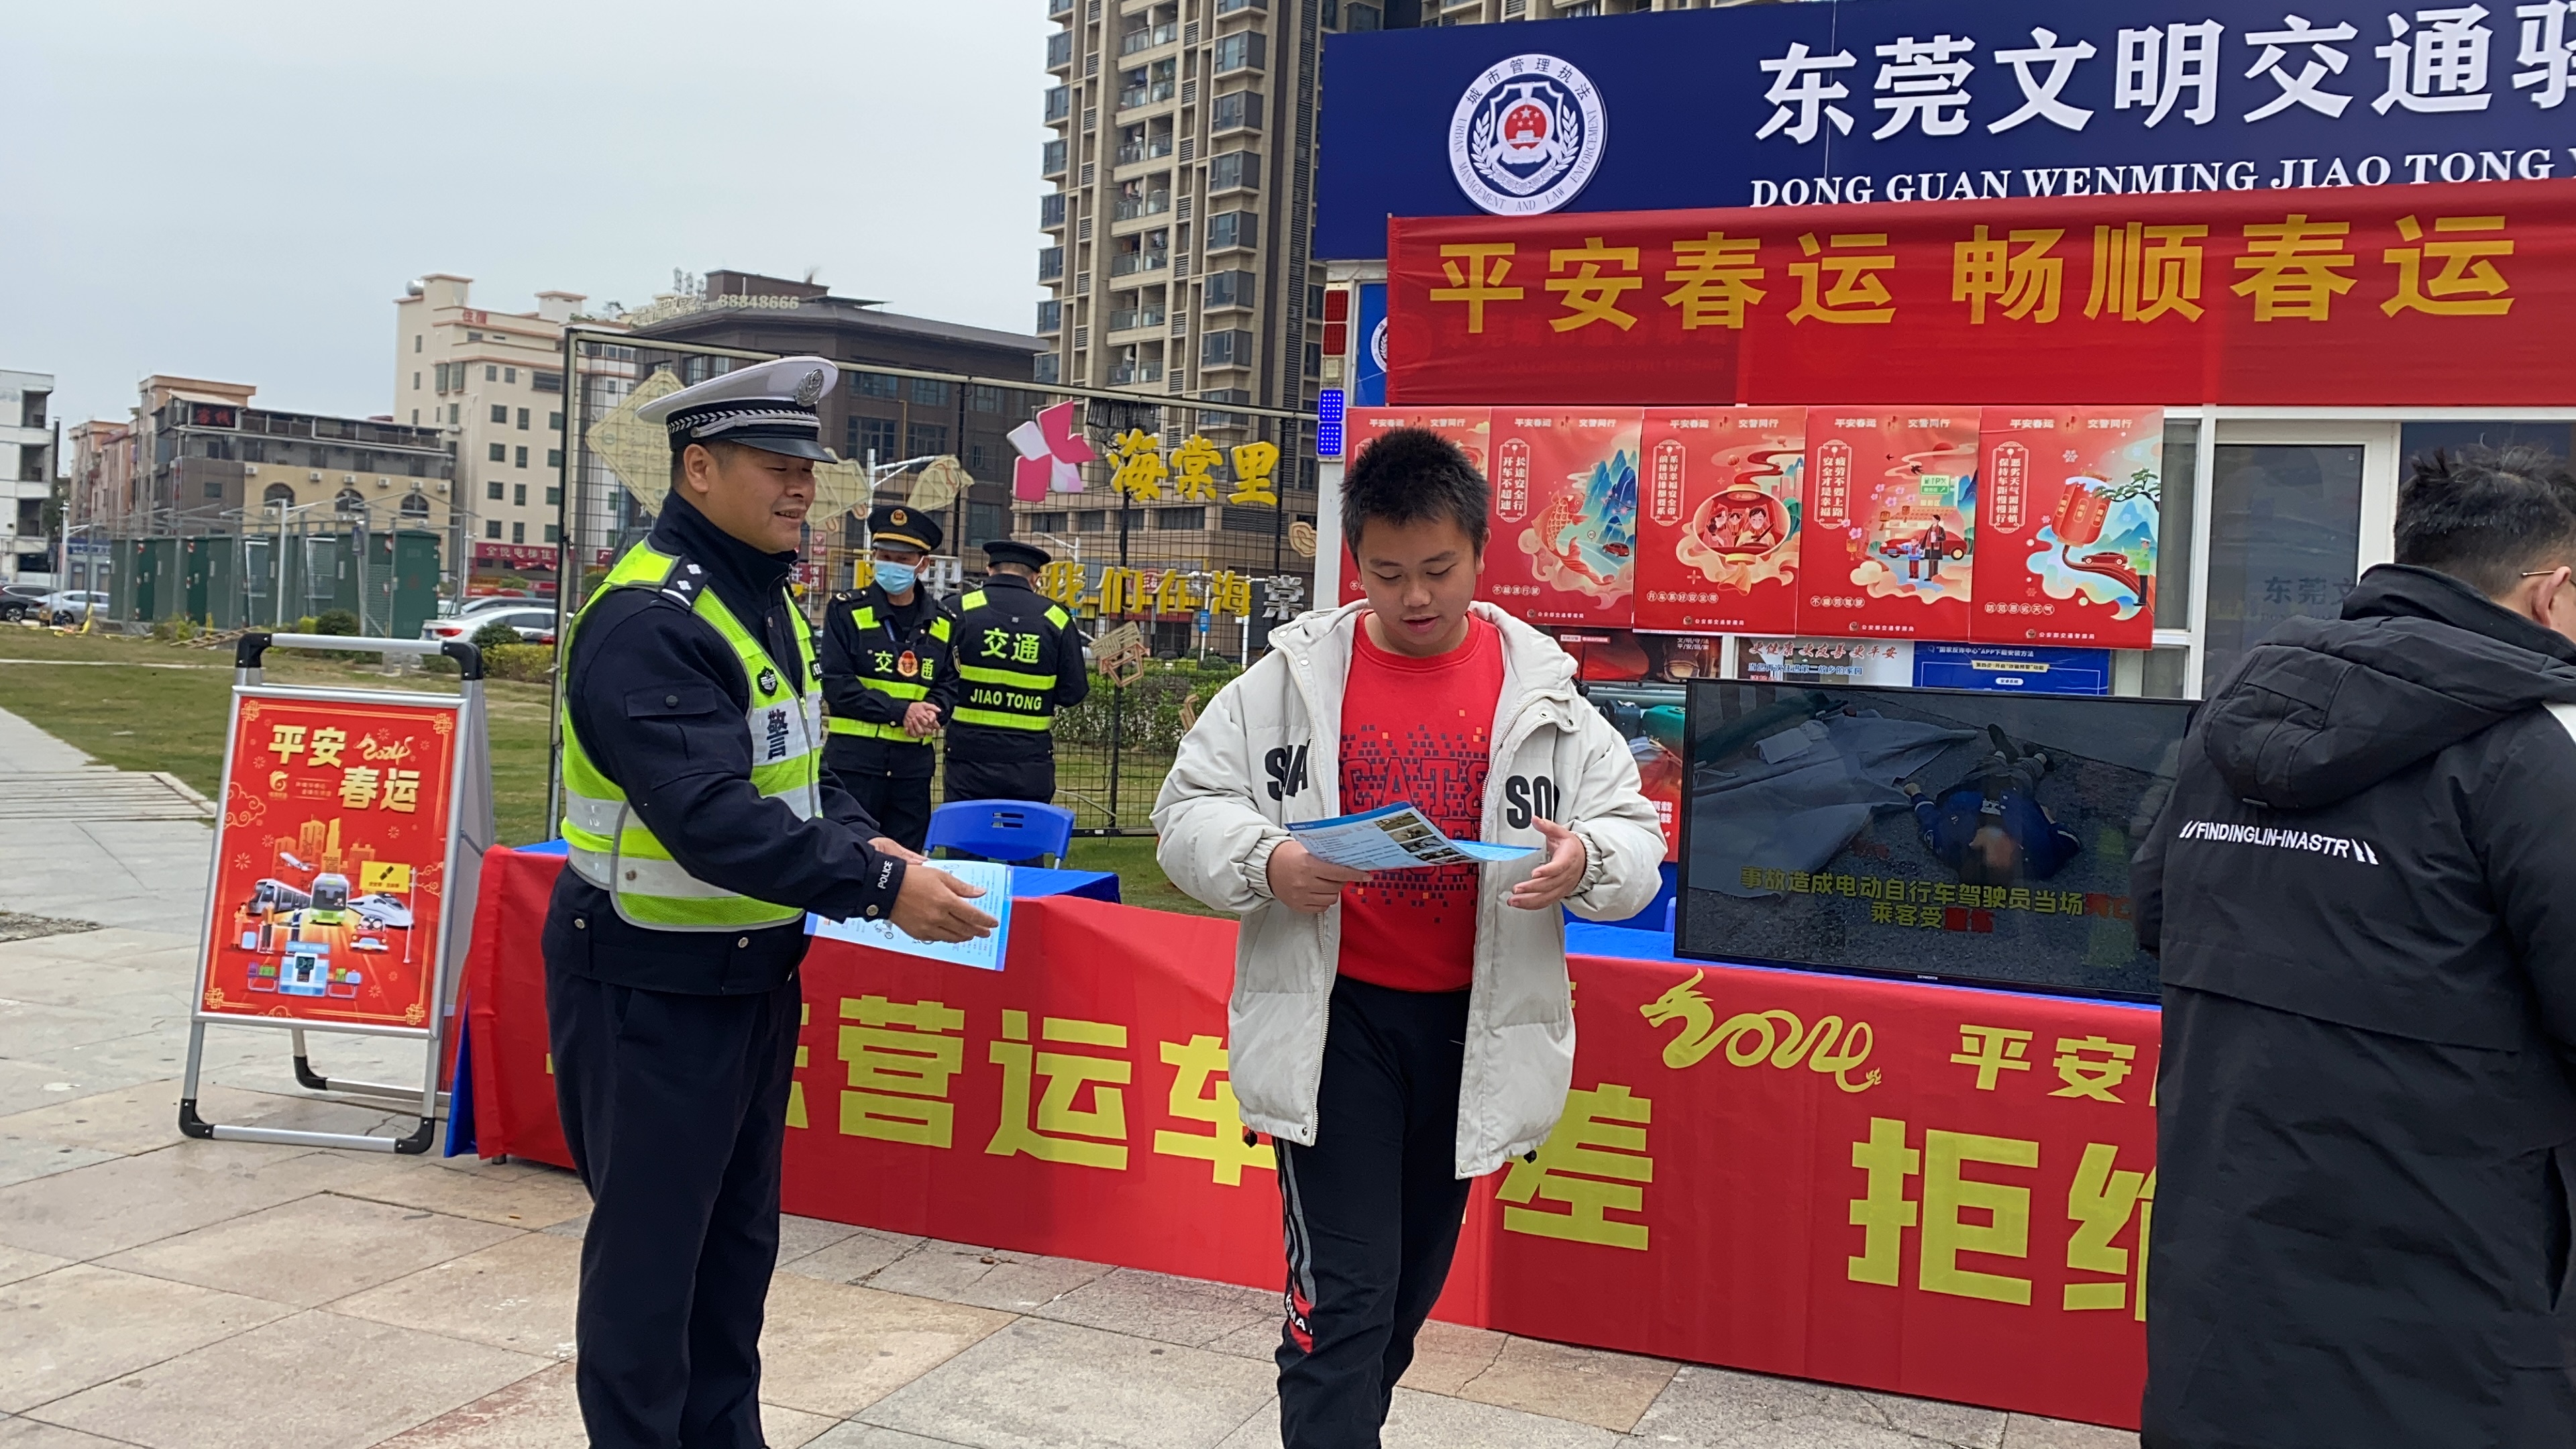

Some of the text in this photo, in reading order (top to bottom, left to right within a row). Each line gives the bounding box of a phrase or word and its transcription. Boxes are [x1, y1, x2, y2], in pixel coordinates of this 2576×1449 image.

[1466, 58, 1591, 105] 城市管理执法
[1454, 109, 1599, 212] URBAN MANAGEMENT AND LAW ENFORCEMENT
[1750, 149, 2555, 208] DONG GUAN WENMING JIAO TONG
[1430, 214, 2516, 333] 平安春运 畅顺春运
[1369, 418, 1466, 428] 平安春运 交警同行
[1514, 418, 1617, 429] 平安春运 交警同行
[1670, 419, 1779, 429] 平安春运 交警同行
[1835, 419, 1951, 429] 平安春运 交警同行
[2010, 419, 2133, 429] 平安春运 交警同行
[1106, 428, 1279, 506] 海棠里
[874, 650, 894, 674] 交
[981, 627, 1040, 664] 交通
[970, 688, 1042, 710] JIAO TONG
[268, 724, 347, 768] 平安
[766, 708, 789, 760] 警
[337, 765, 421, 813] 春运
[877, 860, 893, 890] POLICE
[1950, 1024, 2157, 1107] 平安
